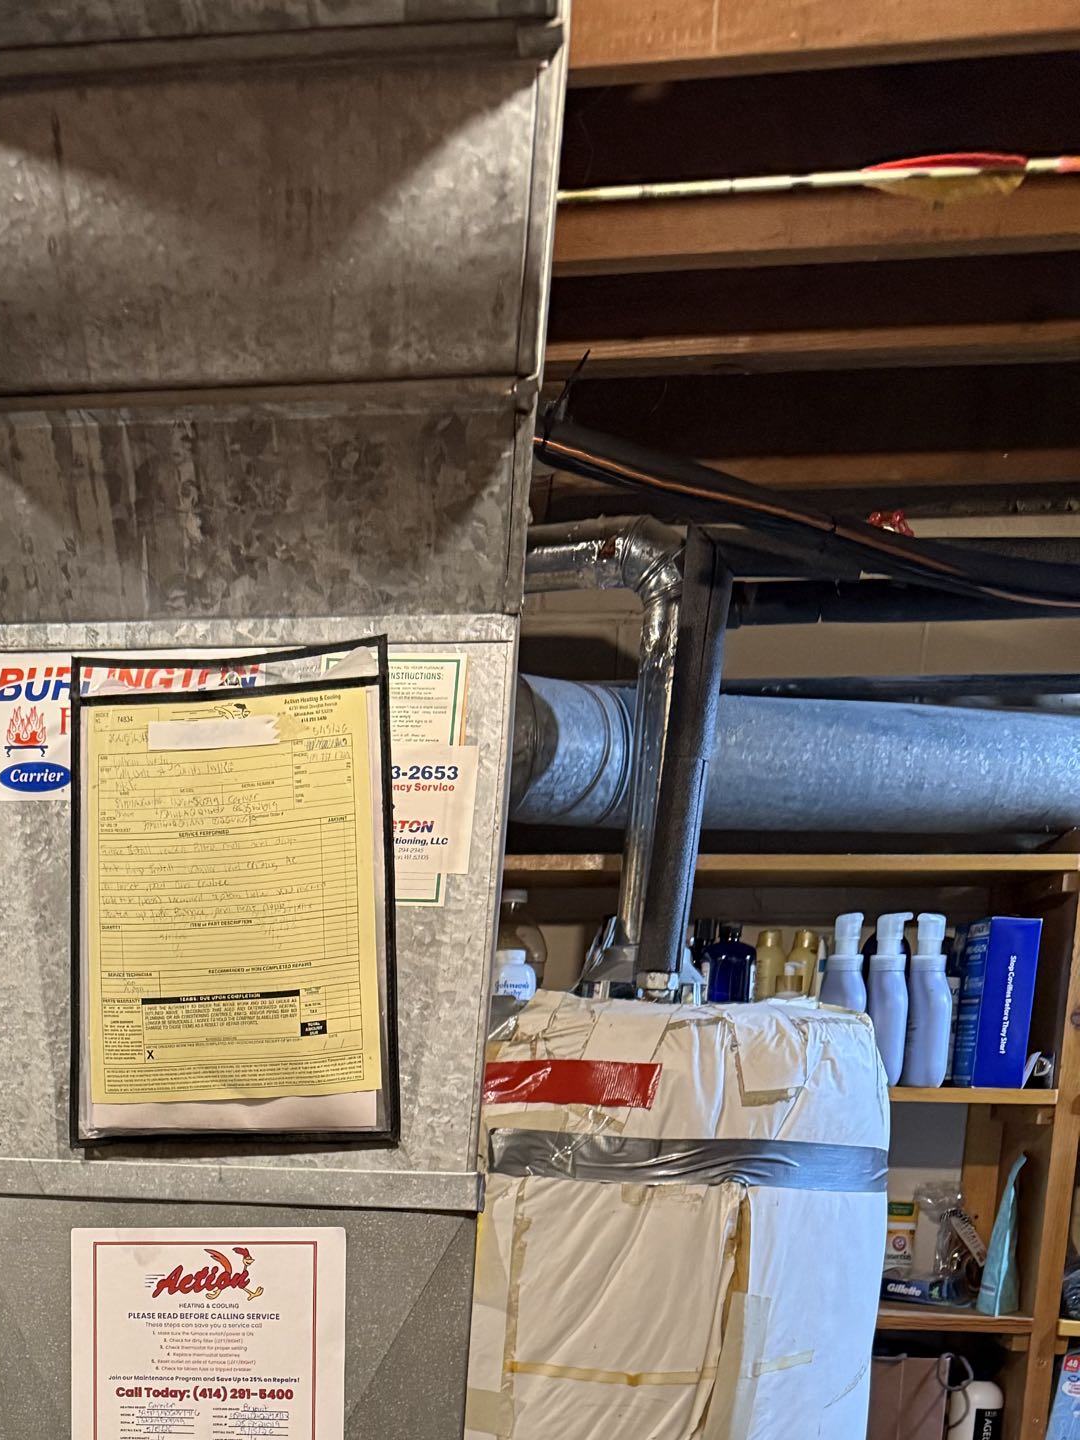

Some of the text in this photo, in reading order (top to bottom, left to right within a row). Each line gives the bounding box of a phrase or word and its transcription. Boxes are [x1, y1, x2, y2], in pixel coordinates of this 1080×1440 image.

[391, 672, 444, 680] NSTRUCTIONS:
[10, 769, 64, 784] Carrier
[415, 783, 454, 791] Service
[1000, 1020, 1009, 1036] They
[151, 1264, 251, 1298] Action
[887, 1283, 922, 1296] Gillette
[128, 1312, 156, 1320] PLEASE
[158, 1312, 178, 1320] READ
[180, 1312, 209, 1320] BEFORE
[212, 1312, 245, 1320] CALLING
[116, 1385, 294, 1402] Call Today: (414) 291-5400
